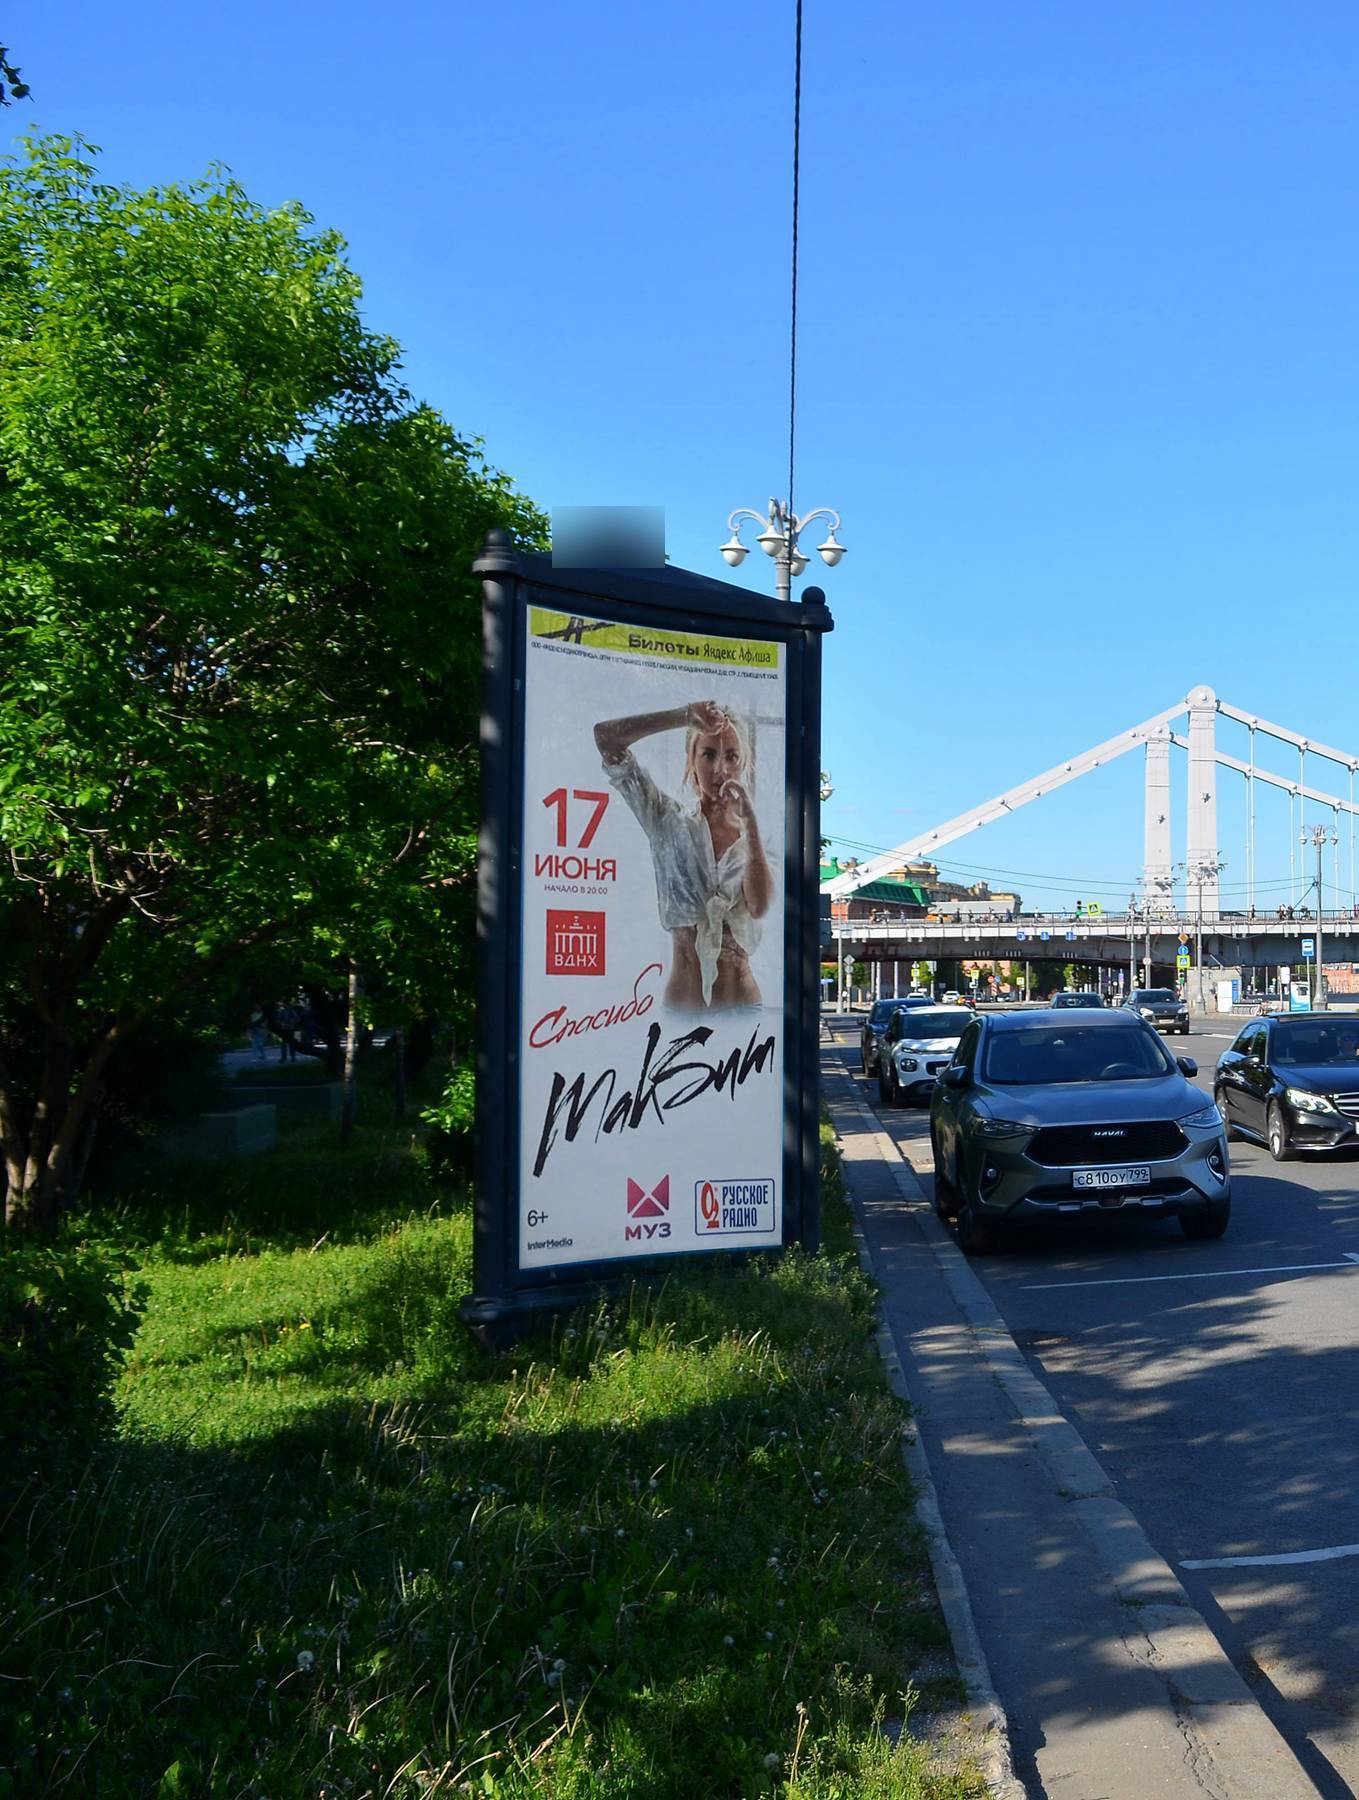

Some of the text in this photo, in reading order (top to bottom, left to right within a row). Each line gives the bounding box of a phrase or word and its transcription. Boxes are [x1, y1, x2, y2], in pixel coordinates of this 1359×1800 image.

[628, 632, 700, 657] Билеты
[703, 642, 736, 661] Яндекс
[738, 647, 771, 664] Афиша
[542, 788, 610, 848] 17
[534, 854, 617, 882] ИЮНЯ
[544, 884, 579, 894] НАЧАЛО
[580, 886, 586, 894] В
[554, 954, 598, 967] ВДНХ
[529, 963, 663, 1048] Спасибо
[722, 1184, 769, 1206] РУССКОЕ
[527, 1210, 549, 1227] 6+
[722, 1207, 758, 1228] РАДИО
[625, 1222, 672, 1241] МУЗ
[527, 1237, 573, 1250] InterMedia
